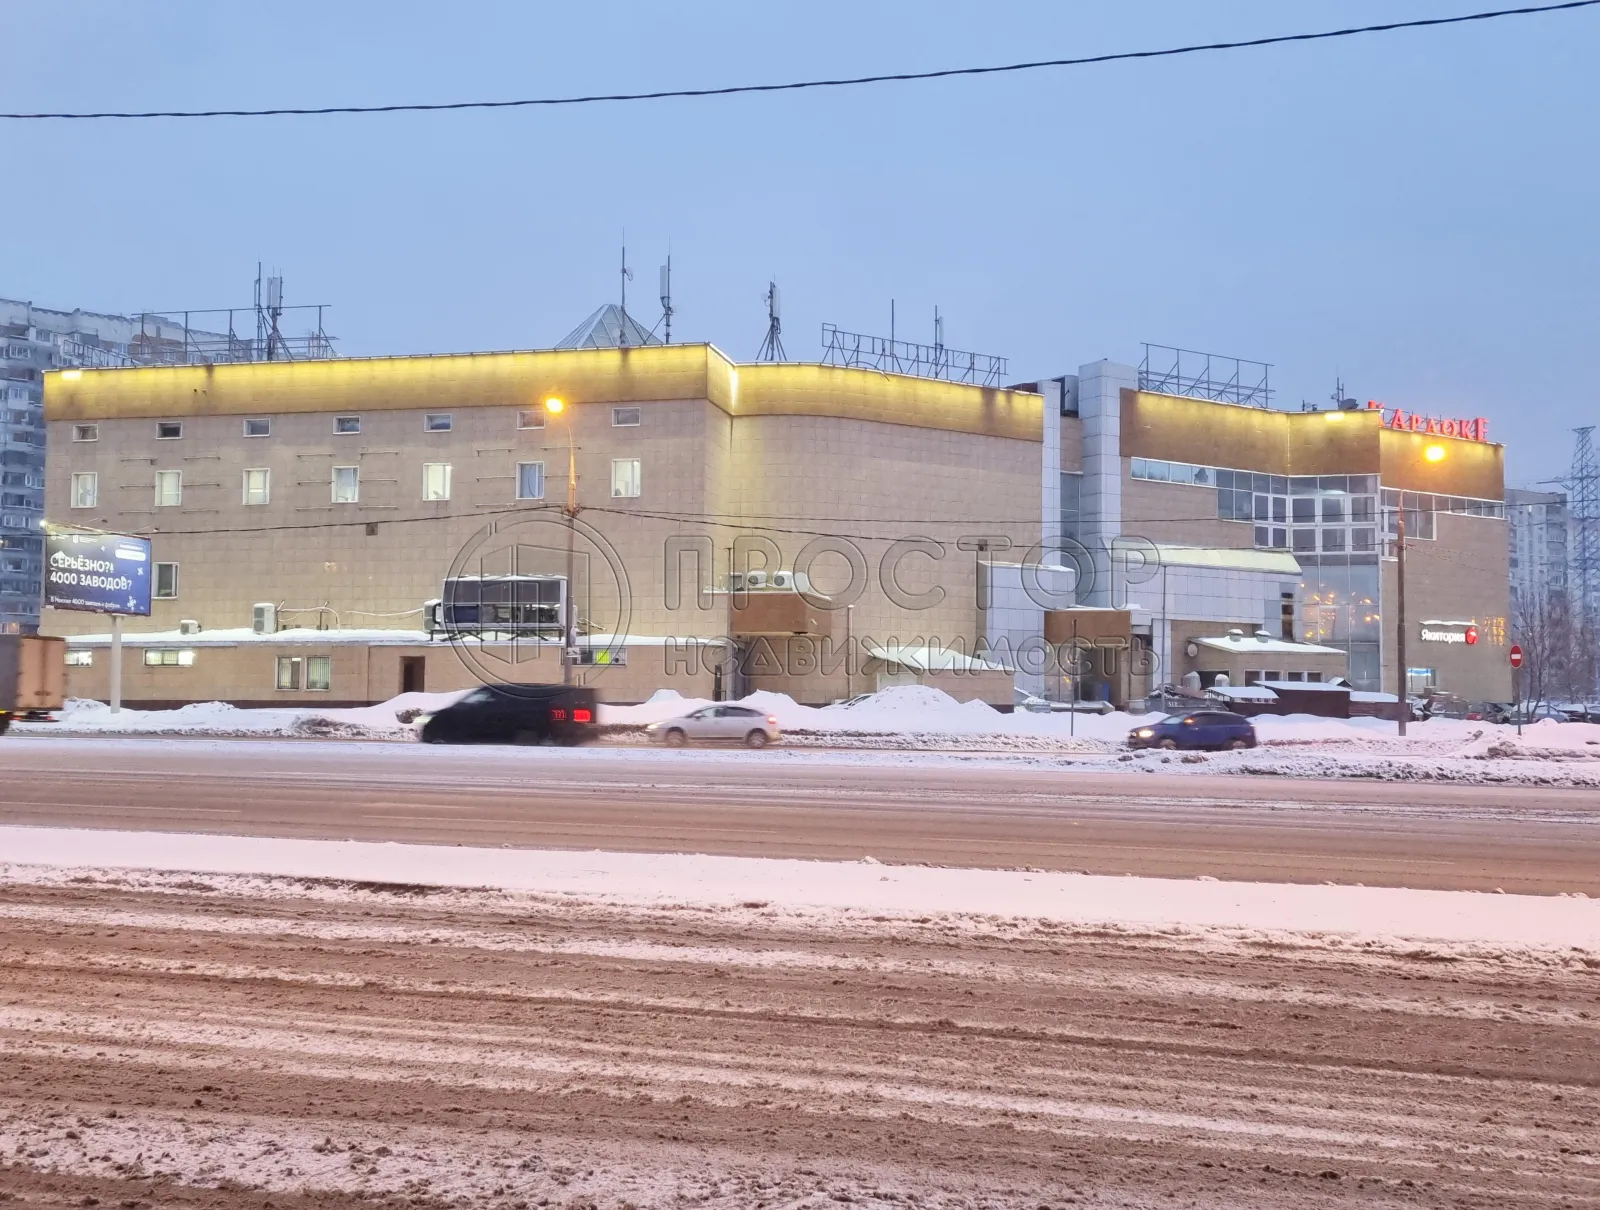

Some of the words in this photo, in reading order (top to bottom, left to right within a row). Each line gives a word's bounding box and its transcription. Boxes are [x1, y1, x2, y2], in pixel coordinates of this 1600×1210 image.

[49, 571, 78, 585] 4000
[79, 575, 132, 591] ЗАВОДОВ?
[1421, 628, 1466, 644] Якитория
